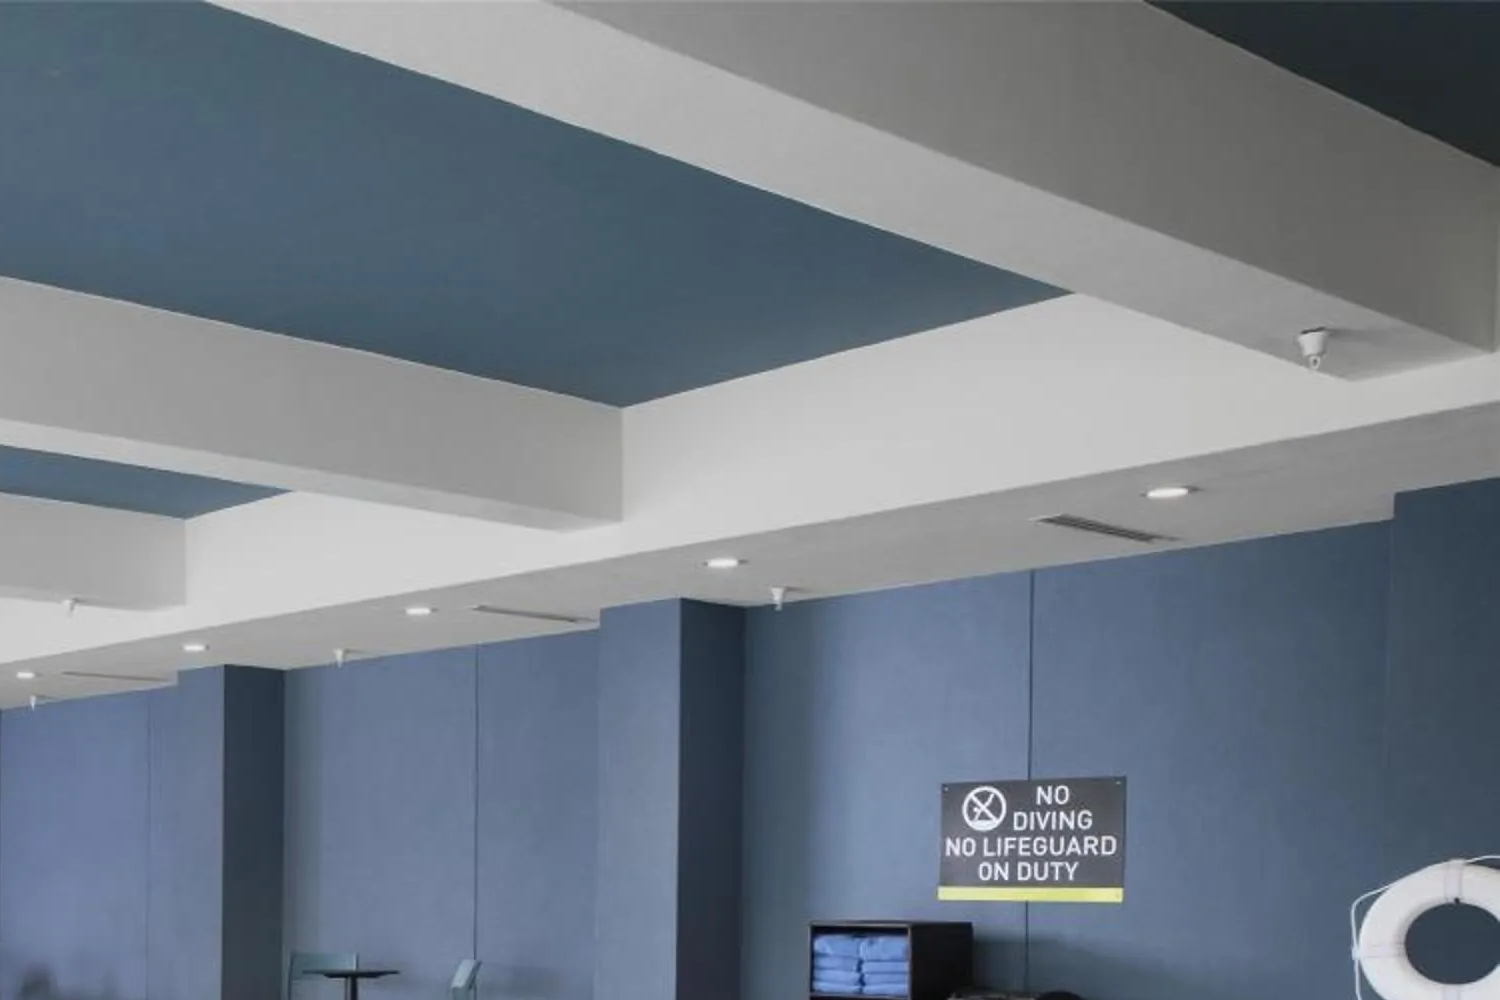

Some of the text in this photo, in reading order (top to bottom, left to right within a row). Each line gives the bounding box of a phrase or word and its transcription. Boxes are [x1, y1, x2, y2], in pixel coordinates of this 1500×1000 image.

[1036, 785, 1069, 805] NO
[1013, 810, 1093, 831] DIVING
[945, 835, 1117, 857] NO LIFEGUARD
[978, 861, 1078, 881] ON DUTY
